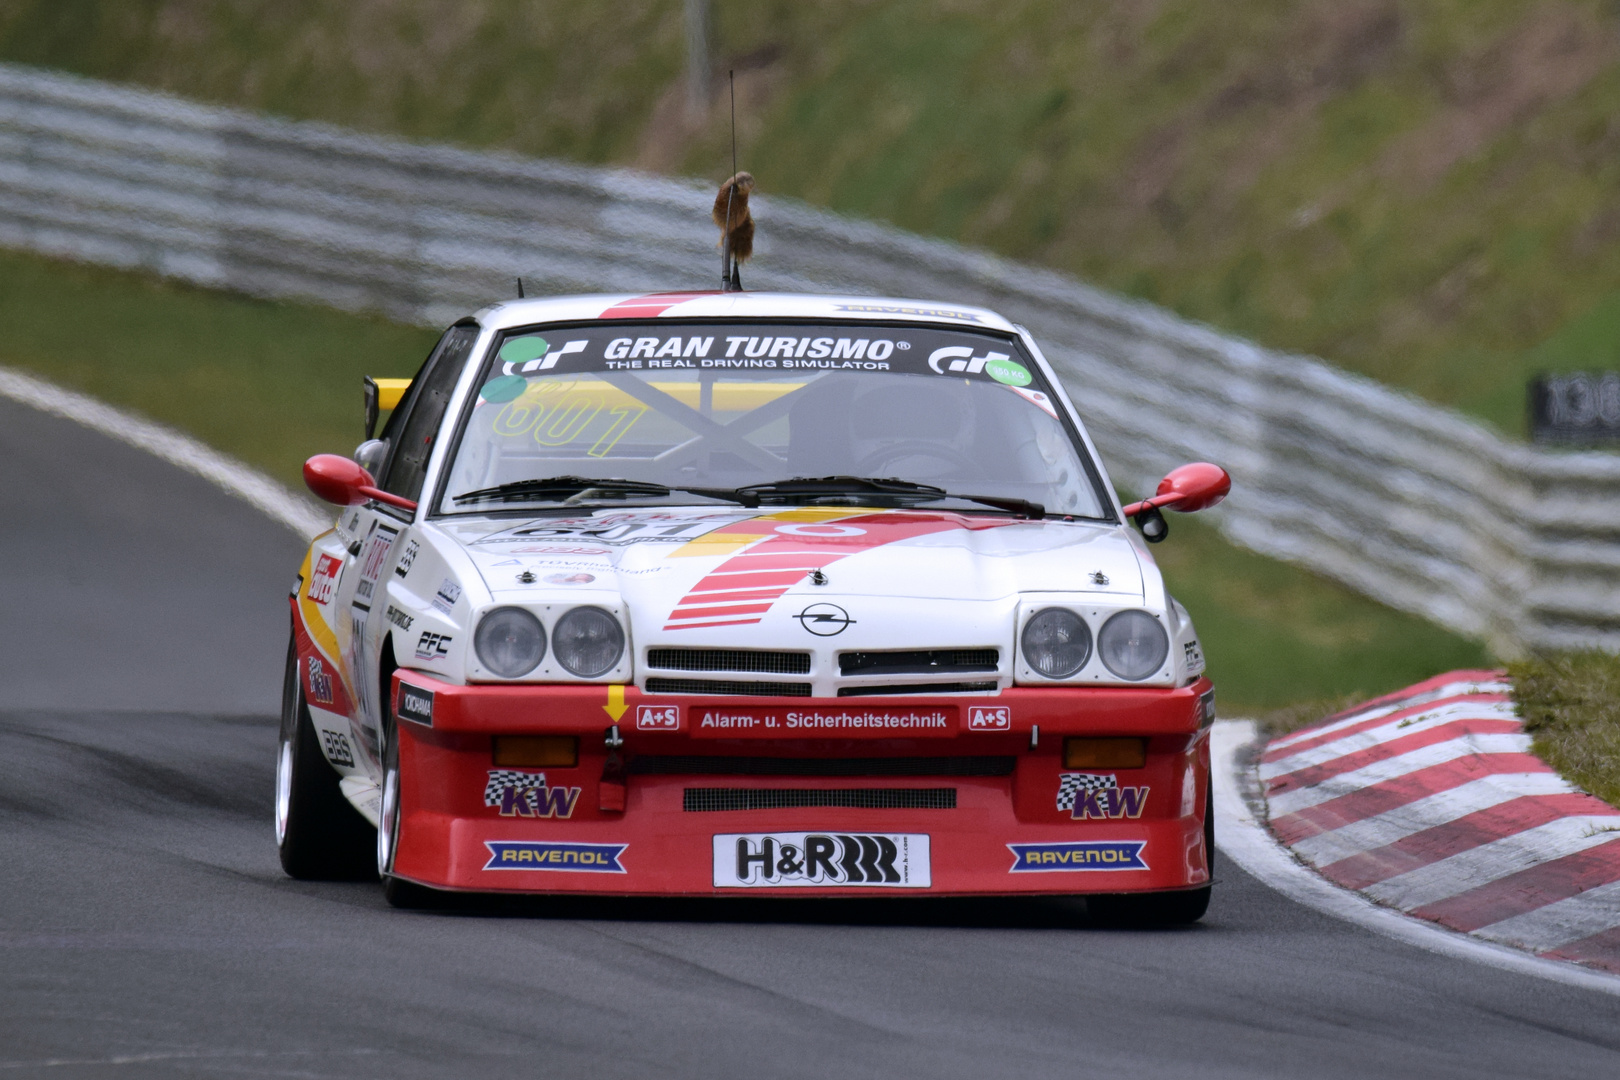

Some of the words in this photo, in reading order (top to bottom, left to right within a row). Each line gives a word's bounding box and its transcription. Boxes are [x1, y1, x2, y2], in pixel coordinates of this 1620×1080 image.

[603, 336, 714, 359] GRAN
[605, 360, 642, 370] THE
[648, 359, 696, 369] REAL
[701, 358, 777, 369] DRIVING
[782, 359, 890, 371] SIMULATOR
[492, 378, 649, 458] 601
[511, 522, 705, 540] 601
[417, 630, 453, 654] PFC
[640, 708, 676, 727] A+S
[700, 712, 760, 728] Alarm-
[764, 715, 781, 728] u.
[785, 712, 947, 729] Sicherheitstechnik
[972, 709, 1007, 728] A+S
[322, 729, 355, 768] BBS
[499, 786, 582, 819] KW
[1070, 786, 1151, 820] KW
[502, 849, 609, 865] RAVENOL
[736, 835, 848, 884] H&R
[1026, 849, 1132, 865] RAVENOL
